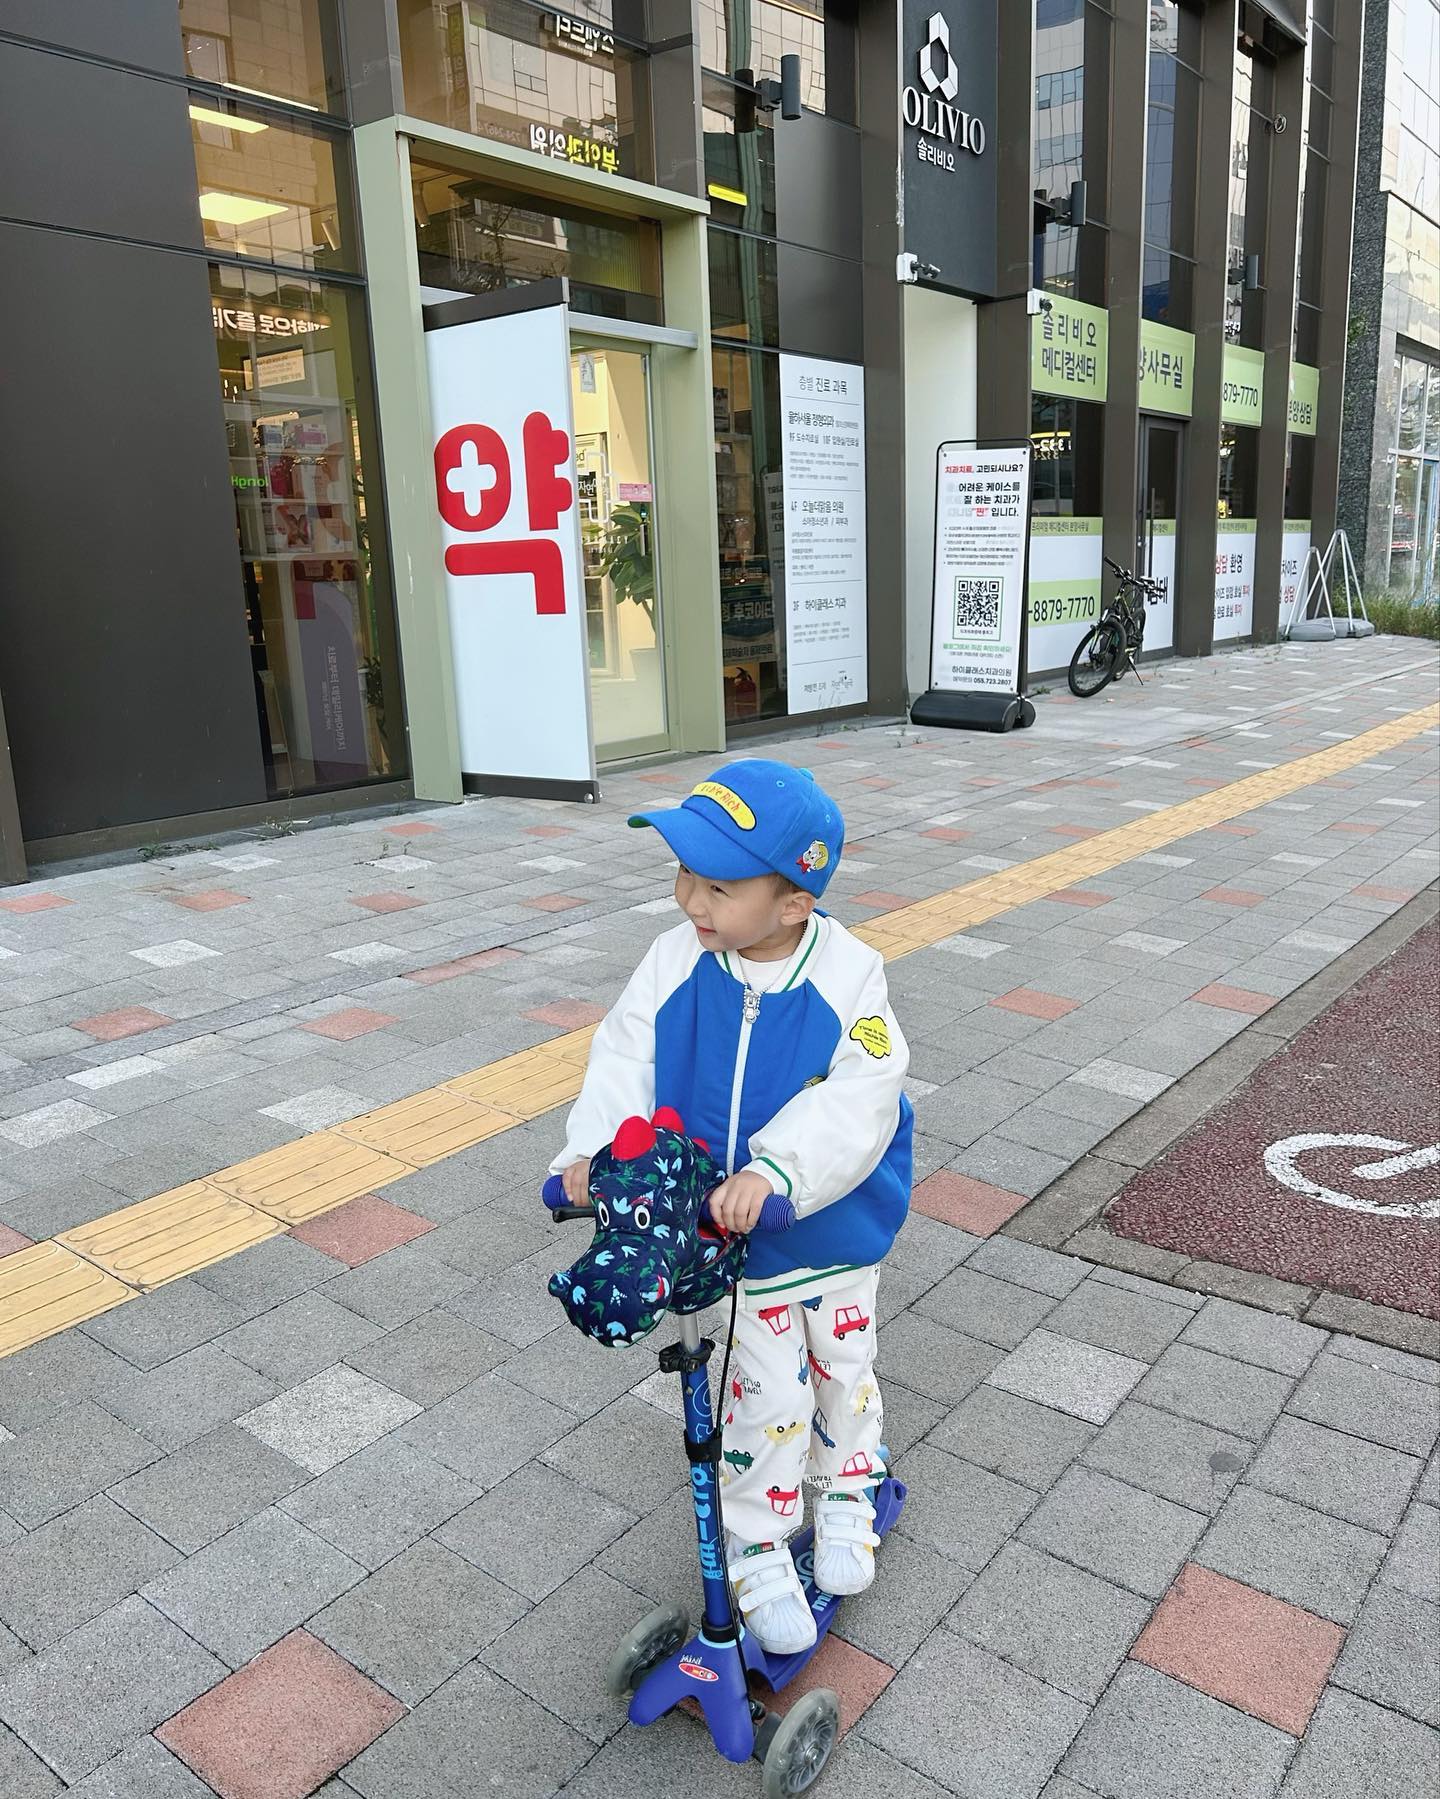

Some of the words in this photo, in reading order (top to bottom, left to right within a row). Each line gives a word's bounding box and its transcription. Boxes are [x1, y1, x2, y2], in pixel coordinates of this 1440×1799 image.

[903, 86, 986, 155] OLIVIO
[917, 136, 956, 172] 솔리비오
[1042, 347, 1096, 386] 메디컬센터
[815, 377, 831, 393] 진료
[832, 380, 848, 395] 과목
[1223, 382, 1259, 408] 879-7770
[976, 463, 1024, 473] 고민되시나요?
[958, 482, 984, 492] 어려운
[986, 481, 1021, 492] 케이스를
[963, 495, 972, 505] 잘
[975, 495, 992, 504] 하는
[994, 494, 1021, 504] 치과가
[434, 411, 573, 616] 약
[991, 507, 1020, 517] 입니다.
[951, 665, 1012, 677] 하이클래스치과의원
